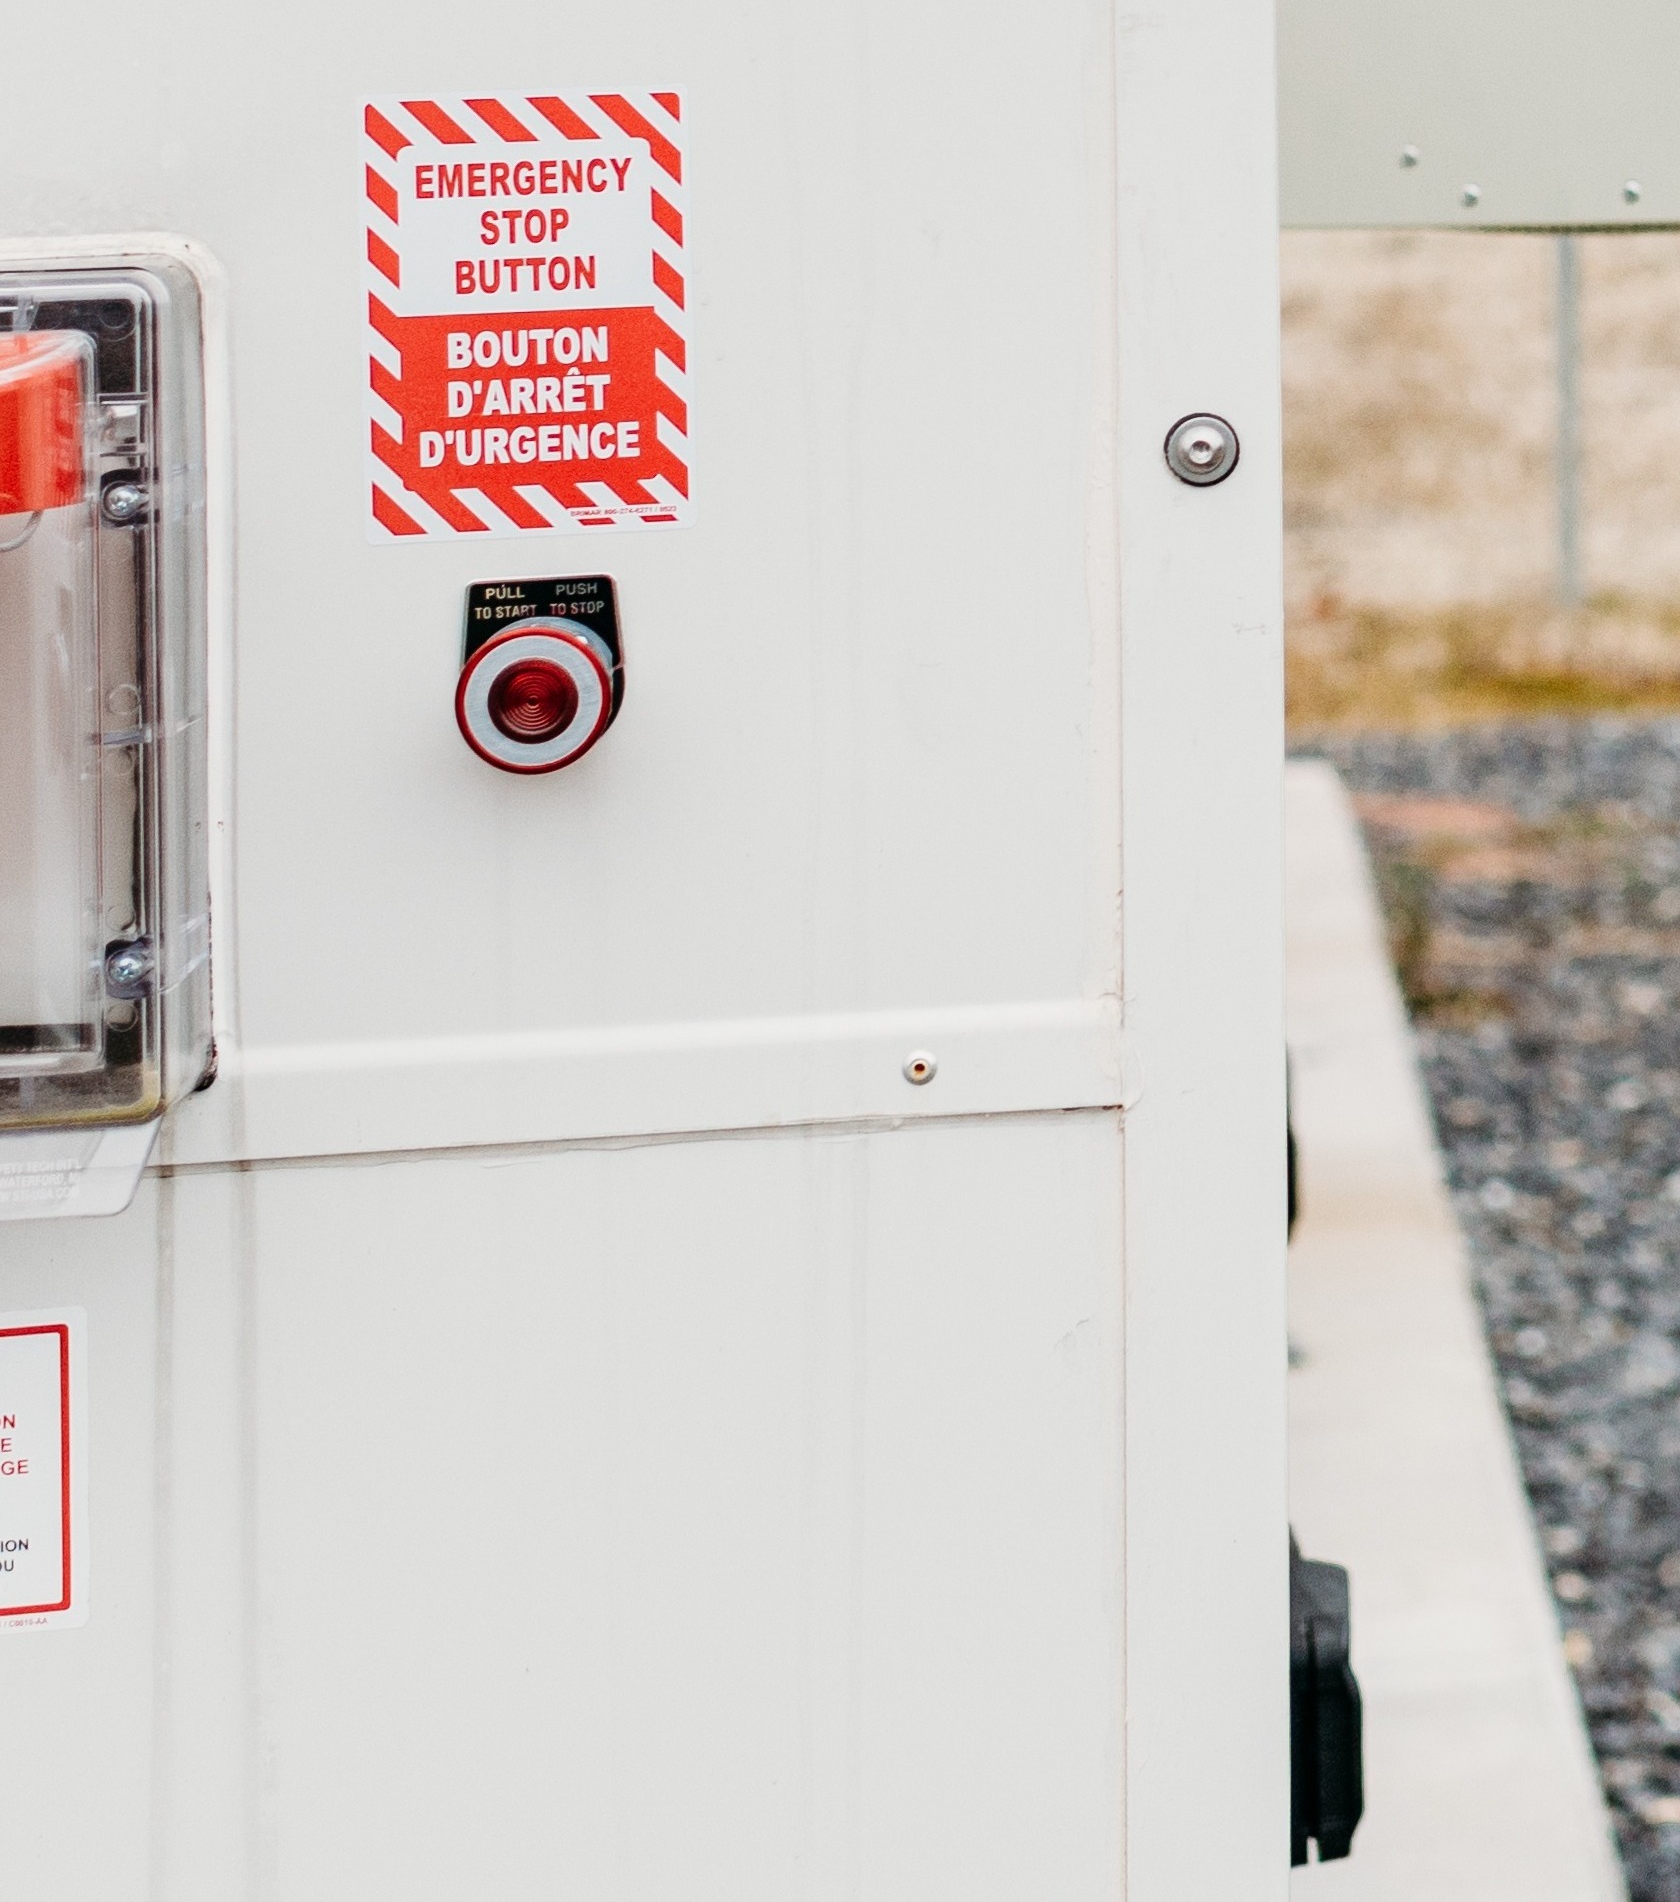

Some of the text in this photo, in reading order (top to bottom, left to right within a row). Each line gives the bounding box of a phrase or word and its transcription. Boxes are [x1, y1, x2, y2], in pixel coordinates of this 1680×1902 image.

[415, 157, 633, 199] EMERGENCY
[480, 208, 570, 245] STOP
[455, 255, 596, 295] BUTTON
[447, 326, 609, 370] BOUTON
[447, 368, 611, 419] D'ARRÊT
[419, 421, 641, 468] D'URGENCE
[485, 585, 525, 600] PULL
[549, 600, 605, 615] TO STOP
[555, 582, 598, 596] PUSH
[474, 604, 537, 620] TO START
[0, 1414, 16, 1429] N
